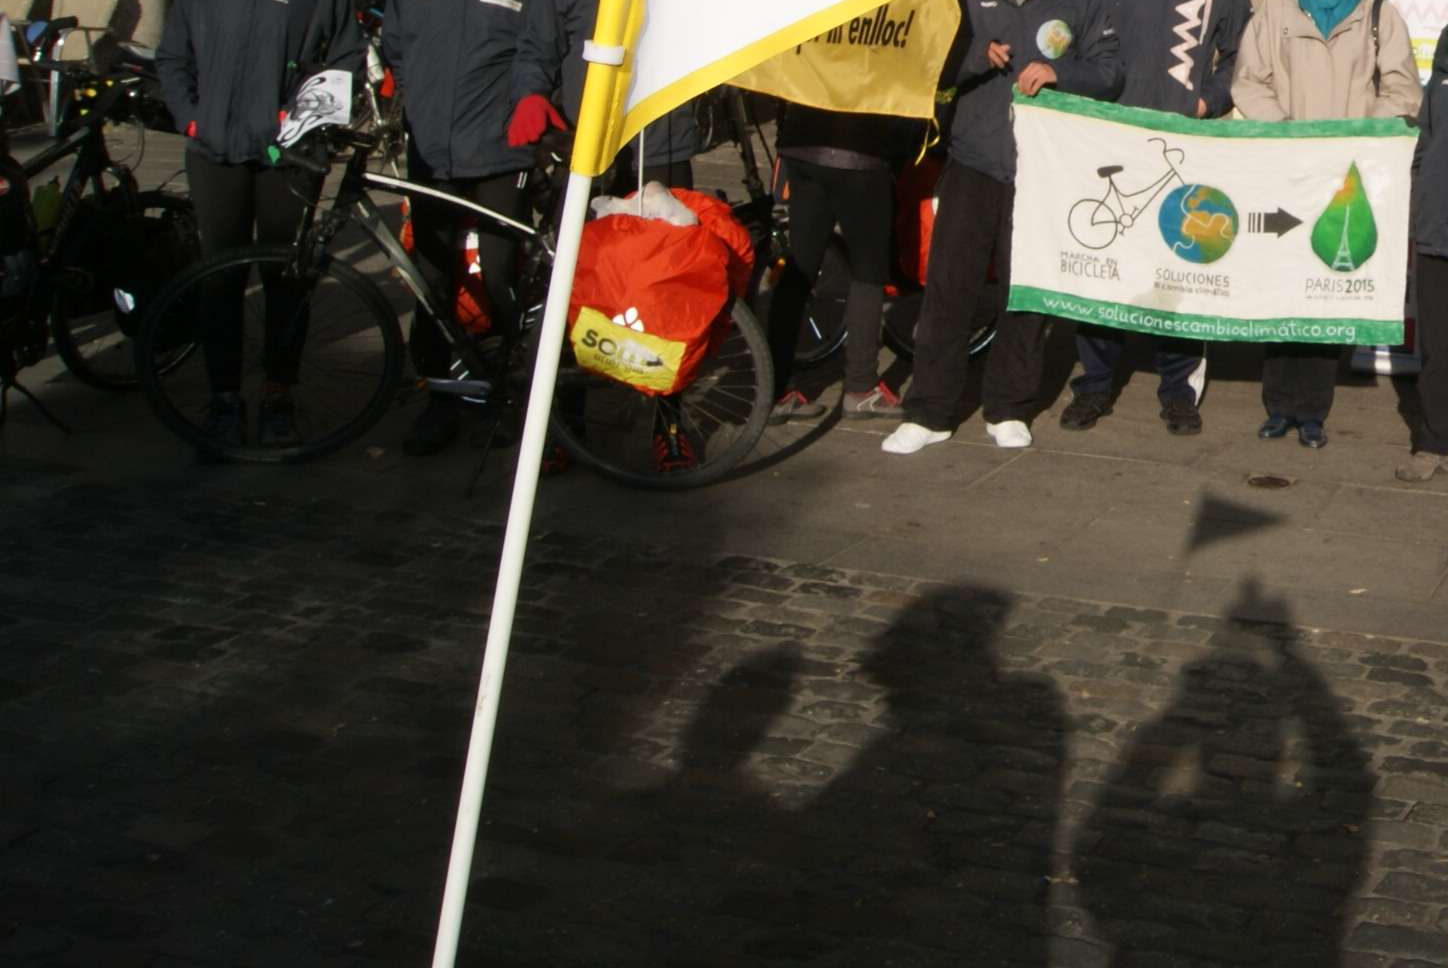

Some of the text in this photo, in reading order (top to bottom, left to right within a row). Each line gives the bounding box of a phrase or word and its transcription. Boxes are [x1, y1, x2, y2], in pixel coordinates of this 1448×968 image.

[849, 4, 916, 49] enlloc!
[1060, 260, 1121, 282] BICICLETA
[1155, 268, 1231, 288] SOLUCIONES
[1305, 278, 1375, 294] PARIS2015
